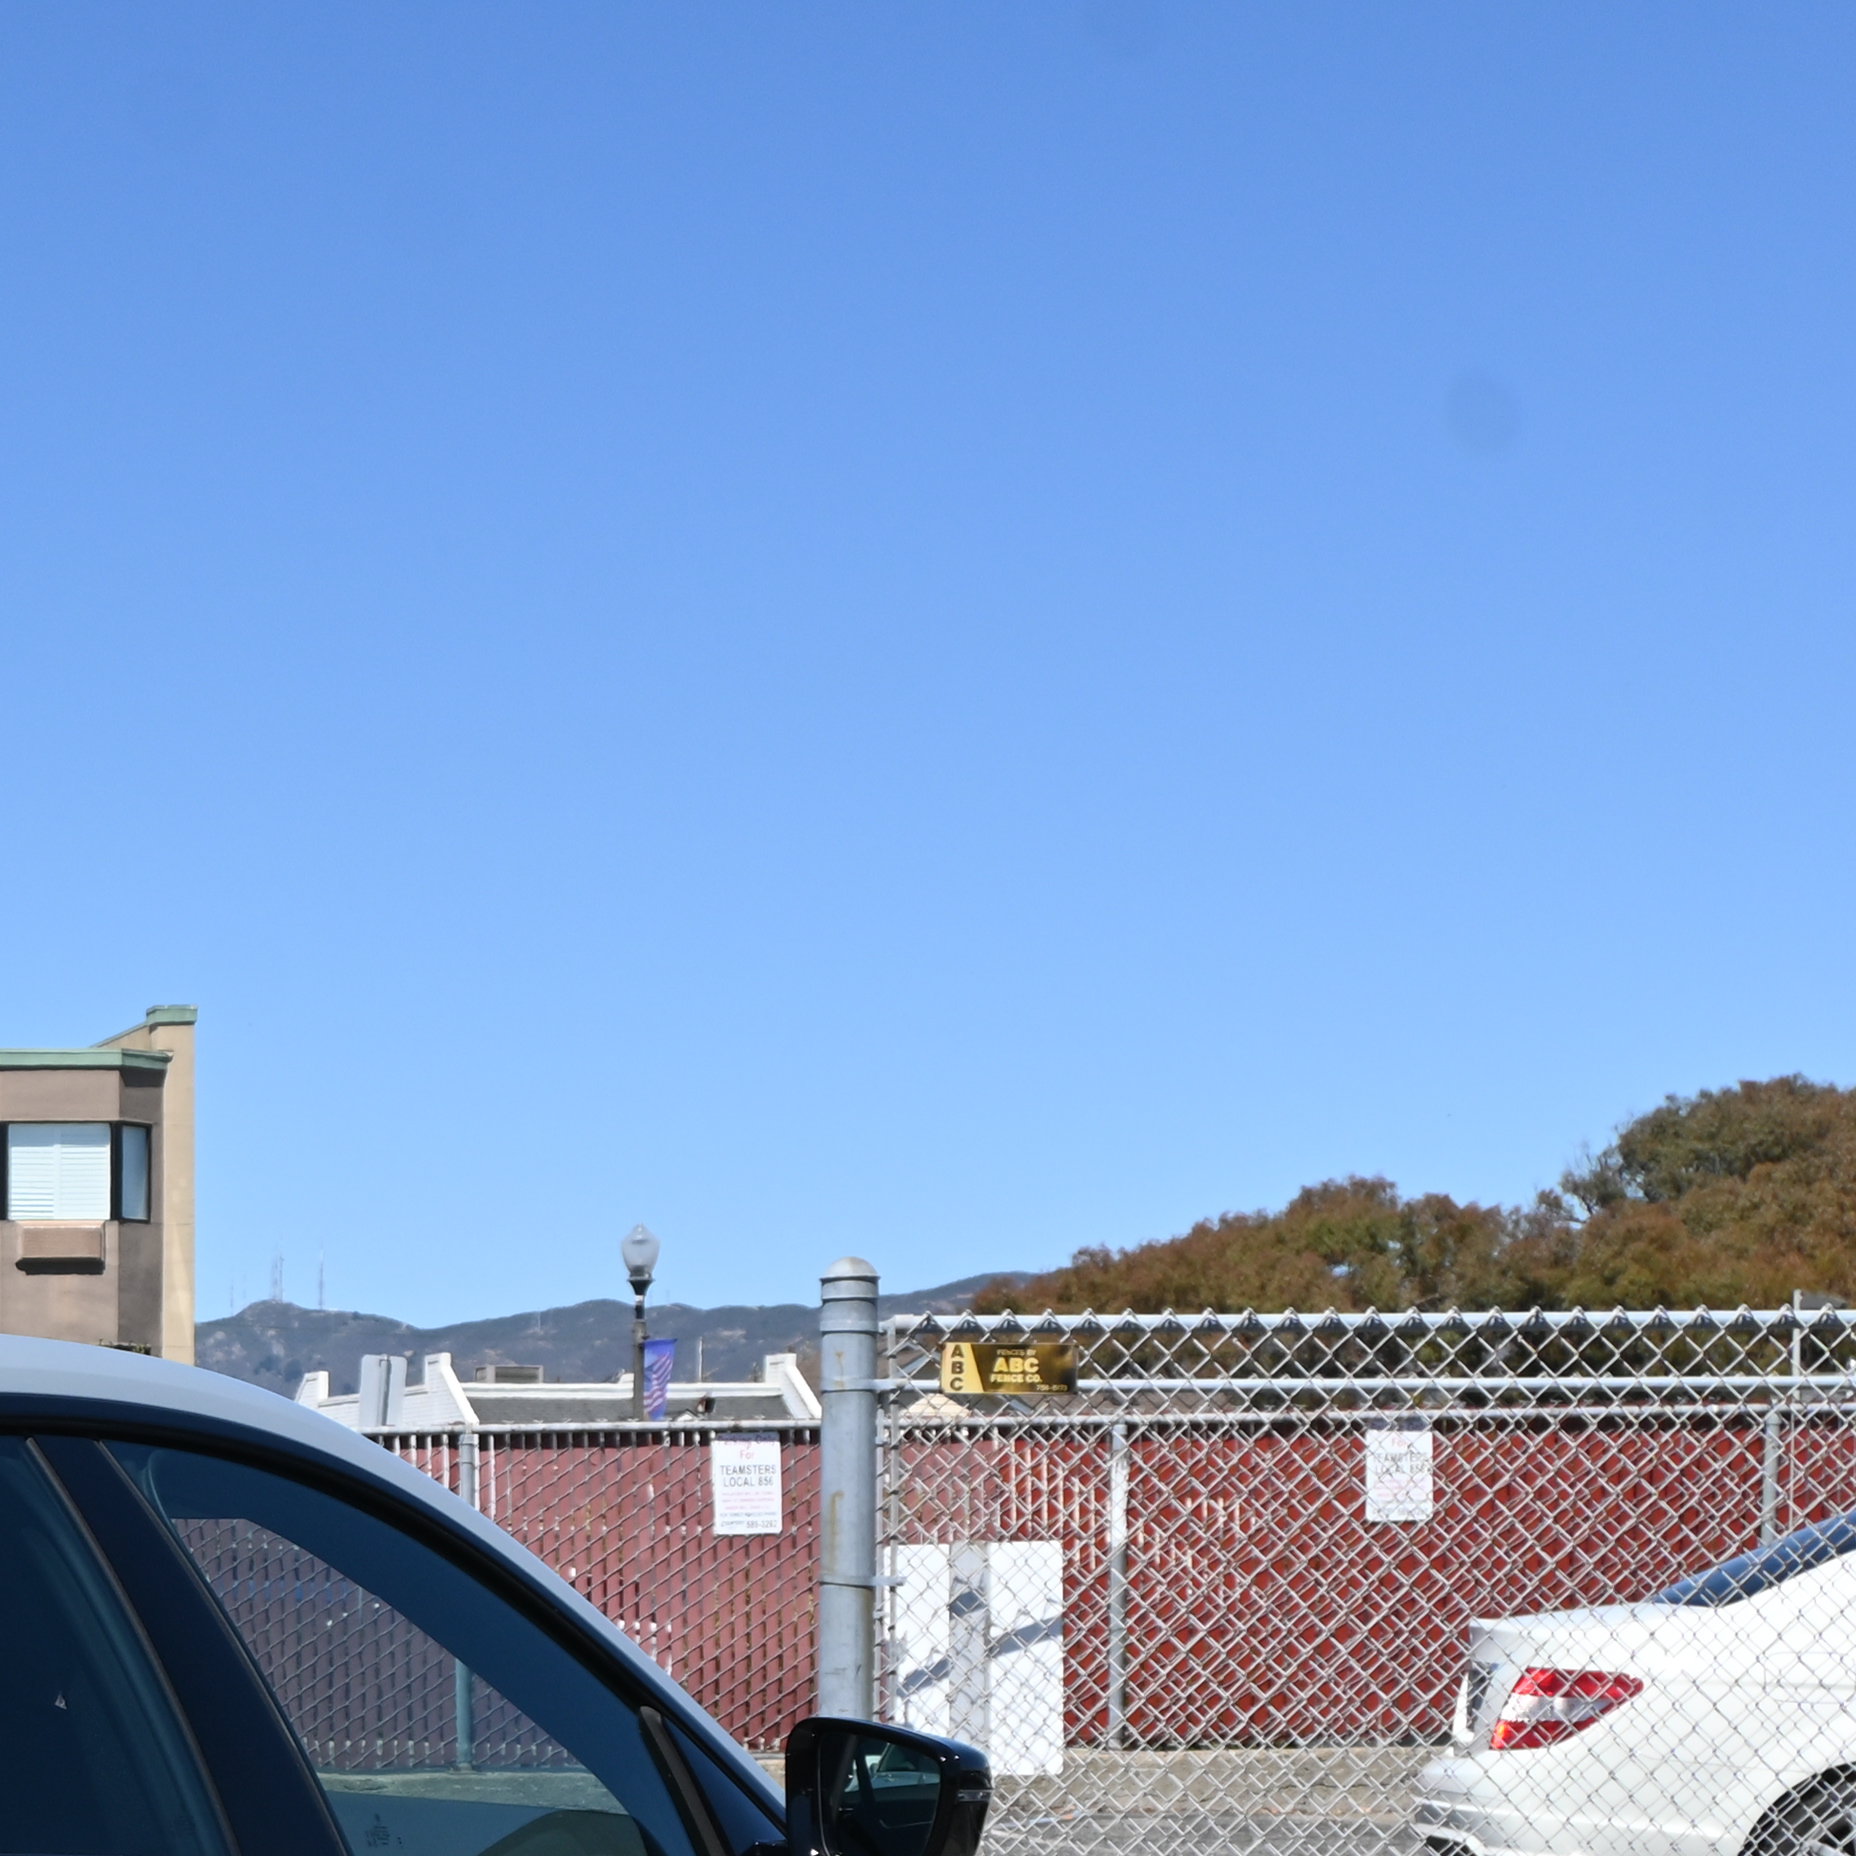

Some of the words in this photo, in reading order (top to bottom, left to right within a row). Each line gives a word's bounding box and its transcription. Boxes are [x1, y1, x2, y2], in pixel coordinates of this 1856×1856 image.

[993, 1357, 1039, 1373] ABC
[990, 1374, 1024, 1383] FENCE
[740, 1450, 754, 1460] For
[720, 1465, 776, 1475] TEAMSTERS
[723, 1476, 755, 1487] LOCAL
[758, 1476, 773, 1486] 856
